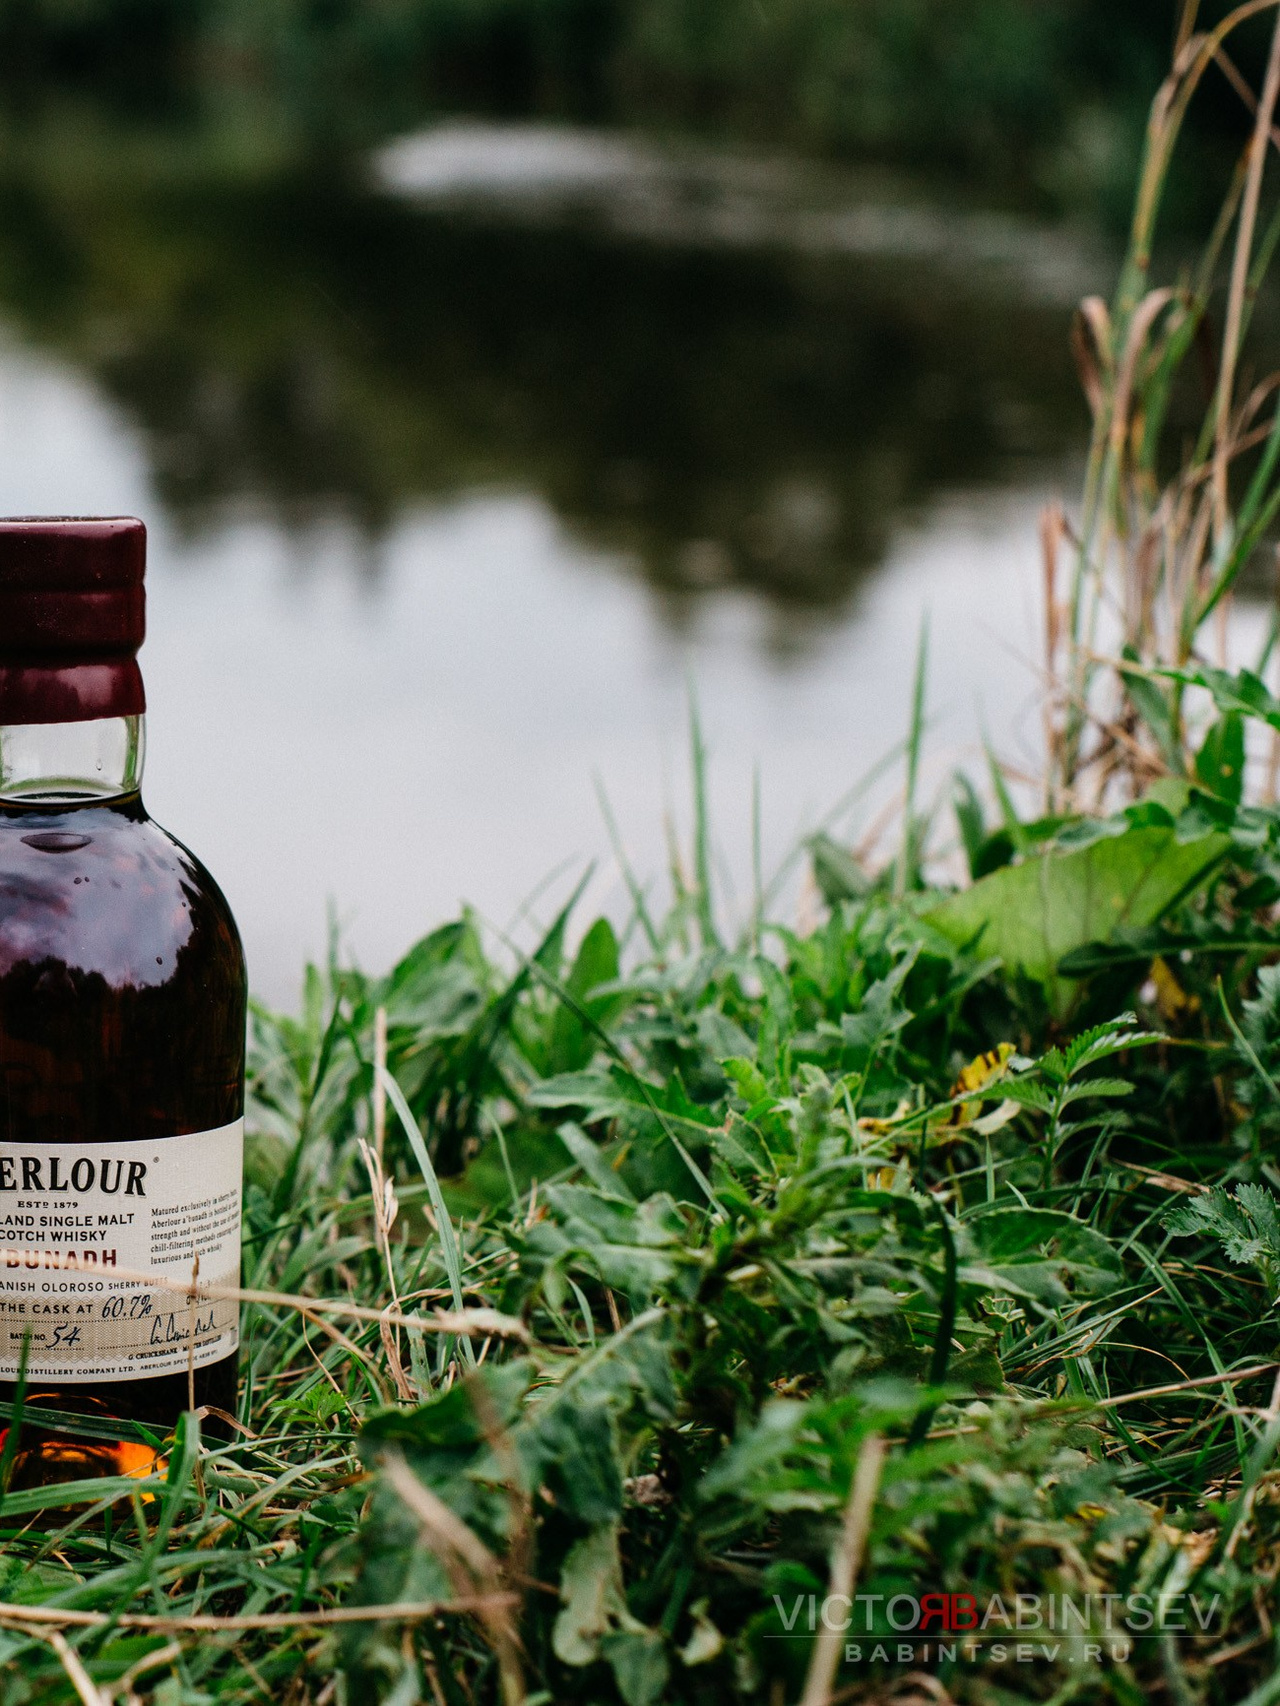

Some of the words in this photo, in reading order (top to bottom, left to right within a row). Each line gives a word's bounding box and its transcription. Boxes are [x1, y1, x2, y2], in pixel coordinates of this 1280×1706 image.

[53, 1201, 78, 1209] 1879
[151, 1205, 179, 1216] Matured
[180, 1199, 211, 1213] exclusively
[40, 1215, 93, 1227] SINGLE
[98, 1213, 135, 1226] MALT
[151, 1218, 181, 1229] Aberlour
[50, 1230, 107, 1242] WHISKY
[151, 1230, 178, 1241] strength
[179, 1227, 191, 1236] and
[151, 1240, 194, 1253] chill-filtering
[150, 1254, 181, 1265] luxurious
[183, 1251, 193, 1260] and
[42, 1282, 104, 1293] OLOROSO
[108, 1281, 141, 1290] SHERRY
[0, 1302, 25, 1313] THE
[32, 1304, 70, 1314] CASK
[76, 1304, 93, 1314] AT
[101, 1294, 153, 1319] 60.7%
[46, 1322, 81, 1348] 54
[77, 1367, 116, 1375] COMPANY
[140, 1361, 171, 1371] ABERLOUR
